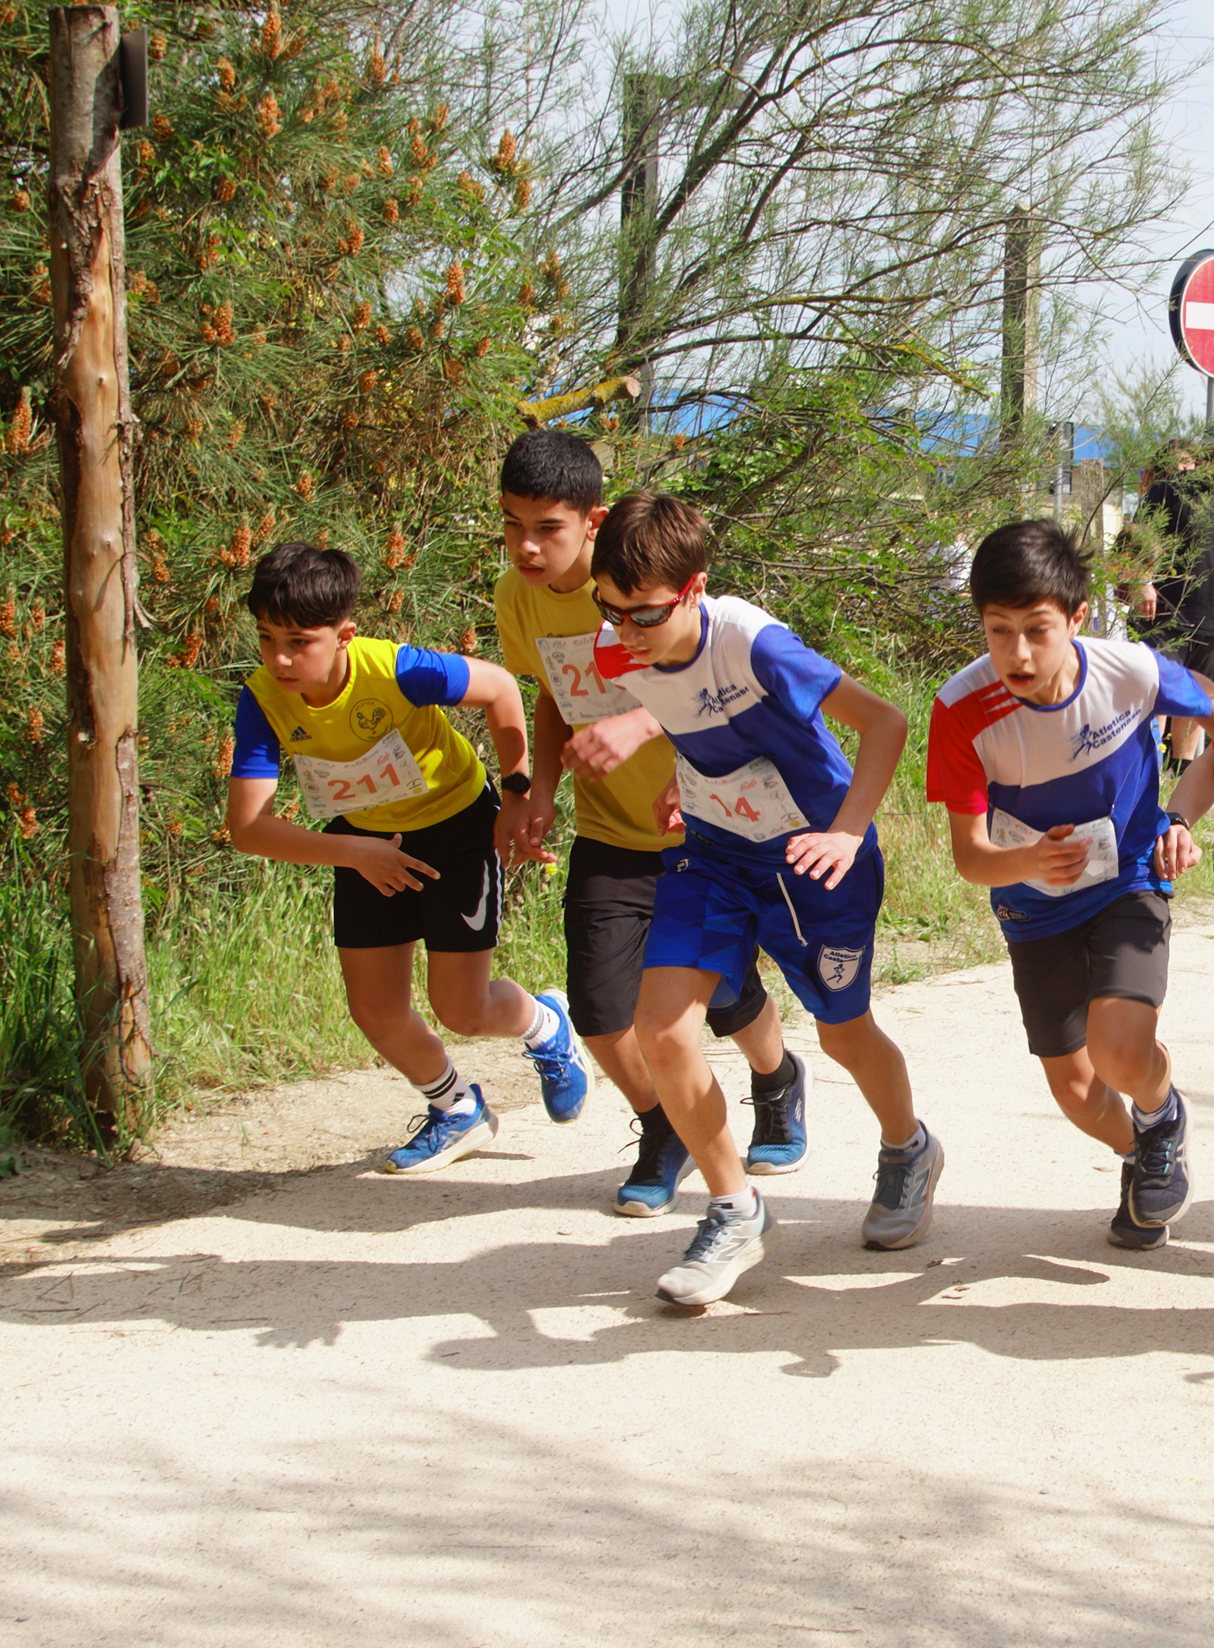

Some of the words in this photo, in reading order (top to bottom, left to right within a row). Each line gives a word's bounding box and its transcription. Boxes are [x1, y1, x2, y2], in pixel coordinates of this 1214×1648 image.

[562, 661, 627, 697] 21
[1092, 709, 1131, 740] Atletica
[327, 763, 401, 801] 211
[709, 793, 761, 822] 14
